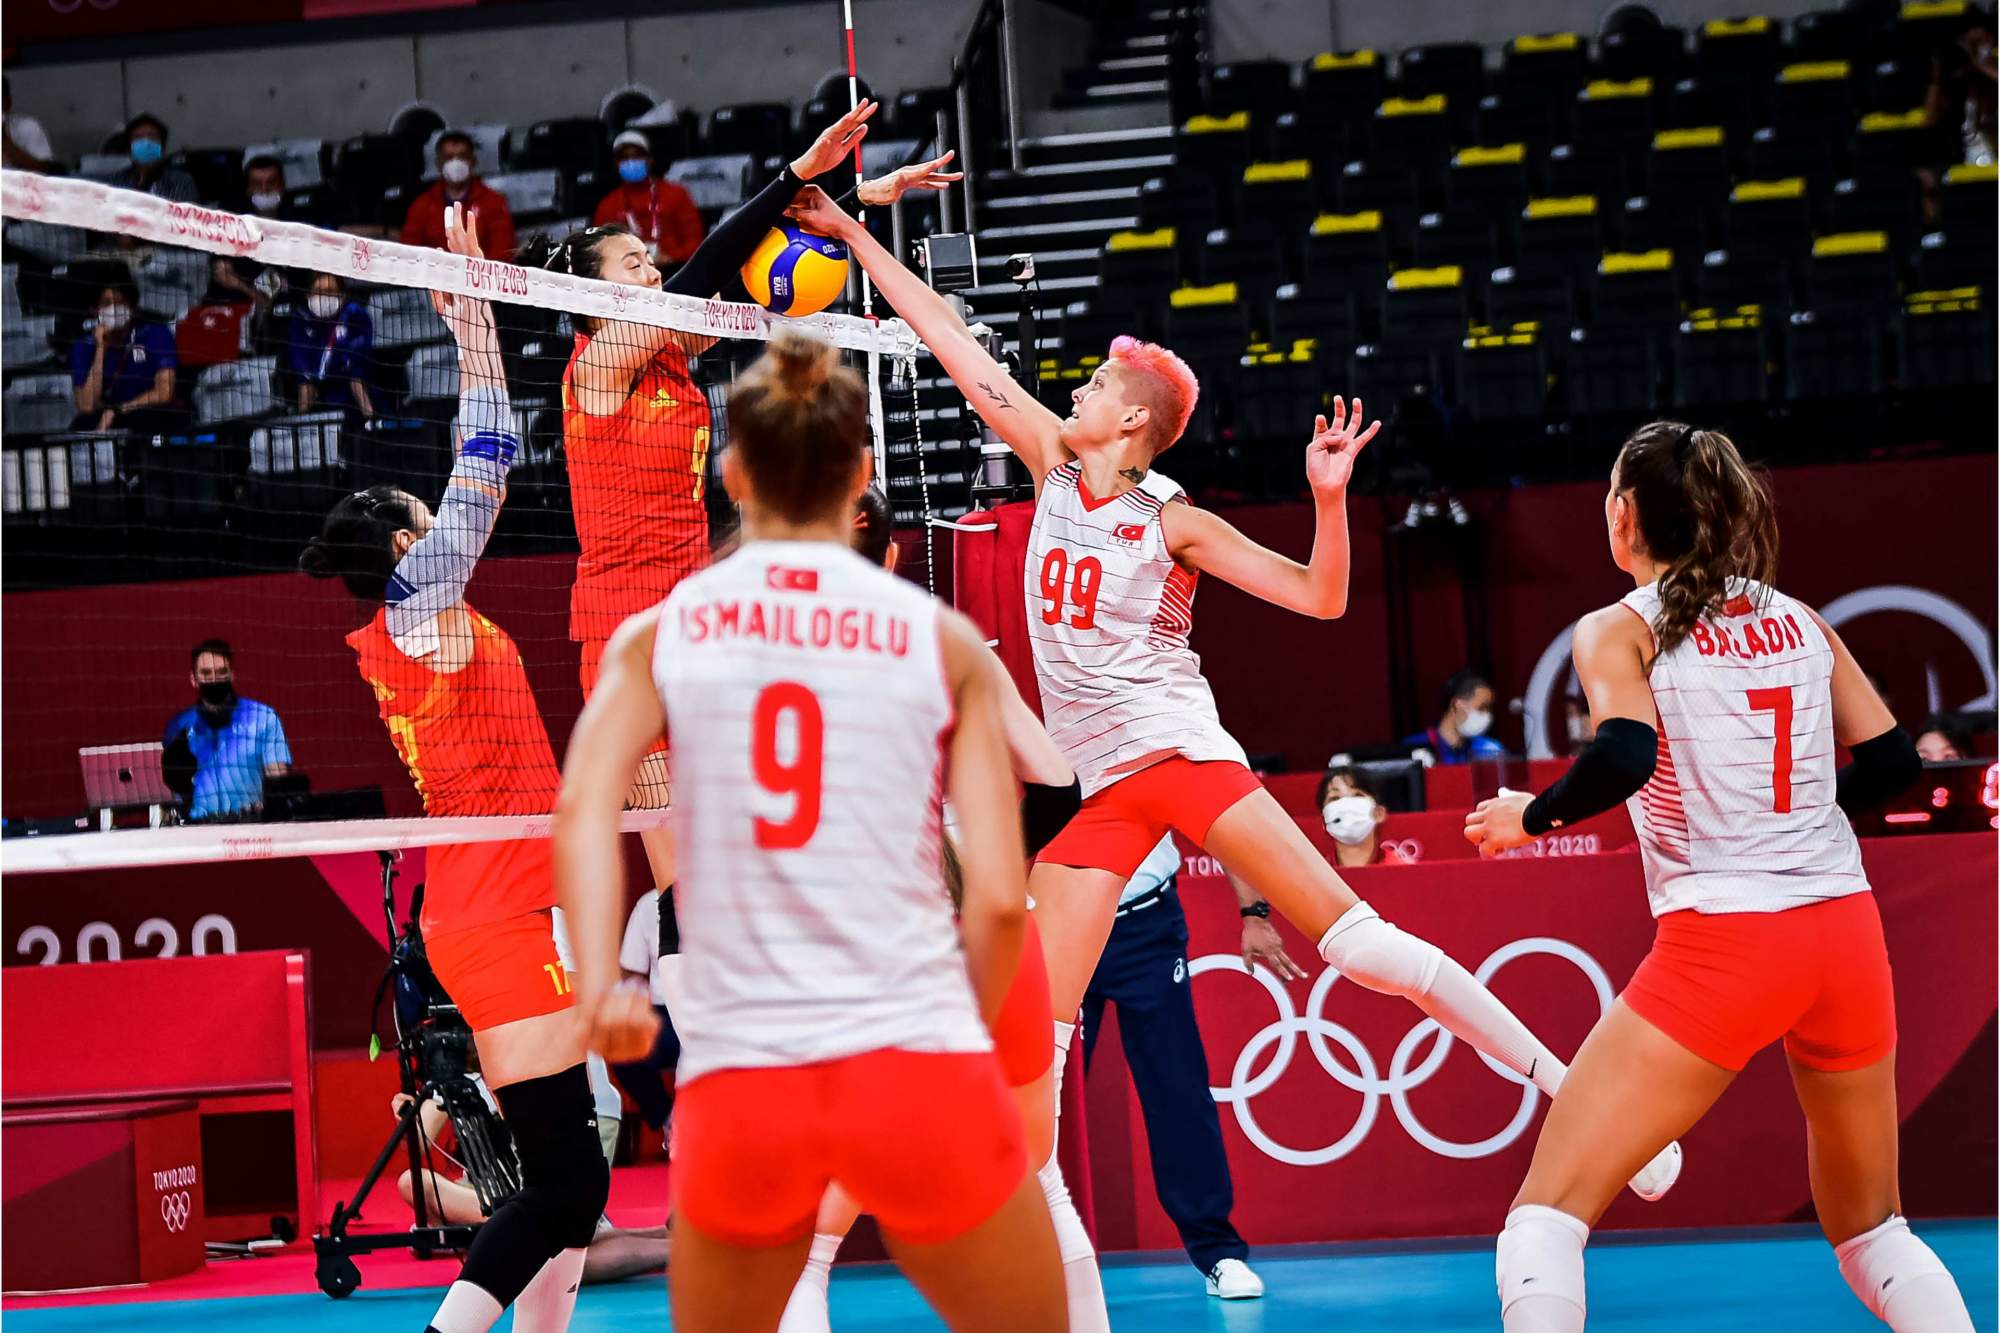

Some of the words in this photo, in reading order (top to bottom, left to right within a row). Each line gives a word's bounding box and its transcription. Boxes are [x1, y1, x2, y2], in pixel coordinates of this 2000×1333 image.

[465, 258, 501, 292] TOKYO
[502, 265, 528, 296] 2020
[704, 301, 733, 330] TOKYO
[734, 304, 758, 331] 2020
[1040, 547, 1102, 630] 99
[752, 679, 824, 850] 9
[1745, 685, 1794, 814] 7
[1547, 834, 1600, 858] 2020
[1184, 856, 1225, 877] TOK
[544, 960, 571, 996] 17
[153, 1168, 178, 1192] TOKYO
[177, 1164, 197, 1187] 2020
